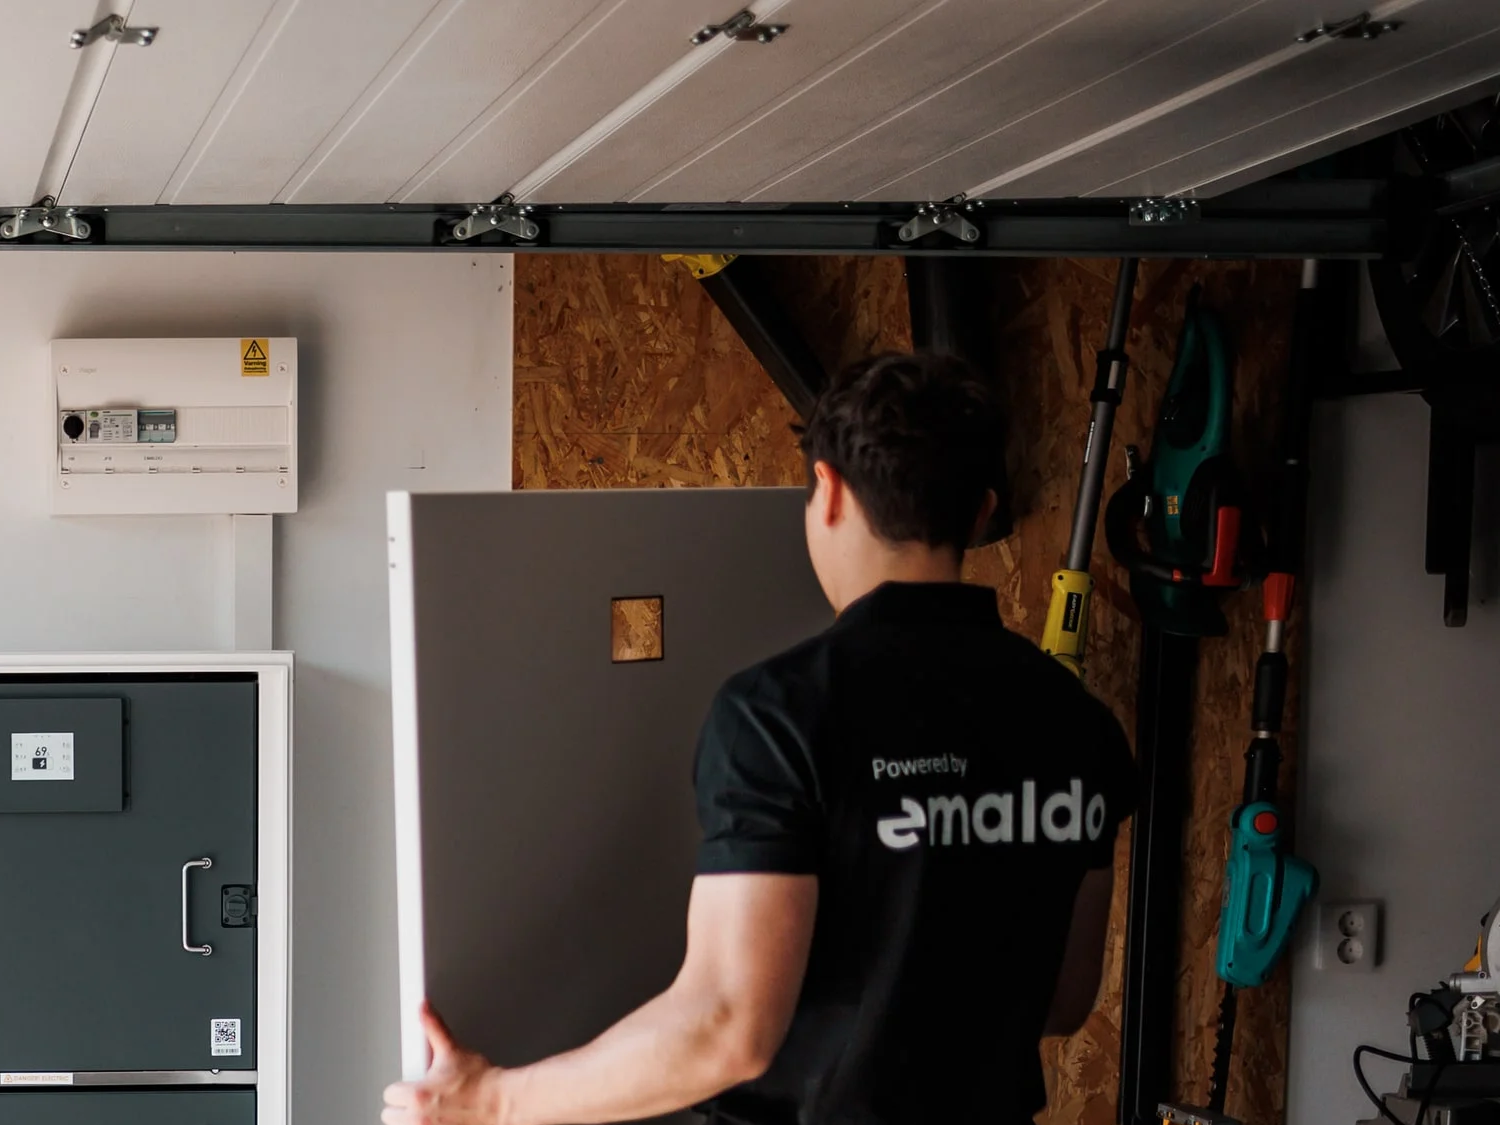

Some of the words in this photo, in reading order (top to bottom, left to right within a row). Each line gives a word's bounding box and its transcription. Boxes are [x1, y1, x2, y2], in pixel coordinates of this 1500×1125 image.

[872, 754, 949, 780] Powered
[950, 753, 968, 778] by
[876, 777, 1106, 850] emaldo
